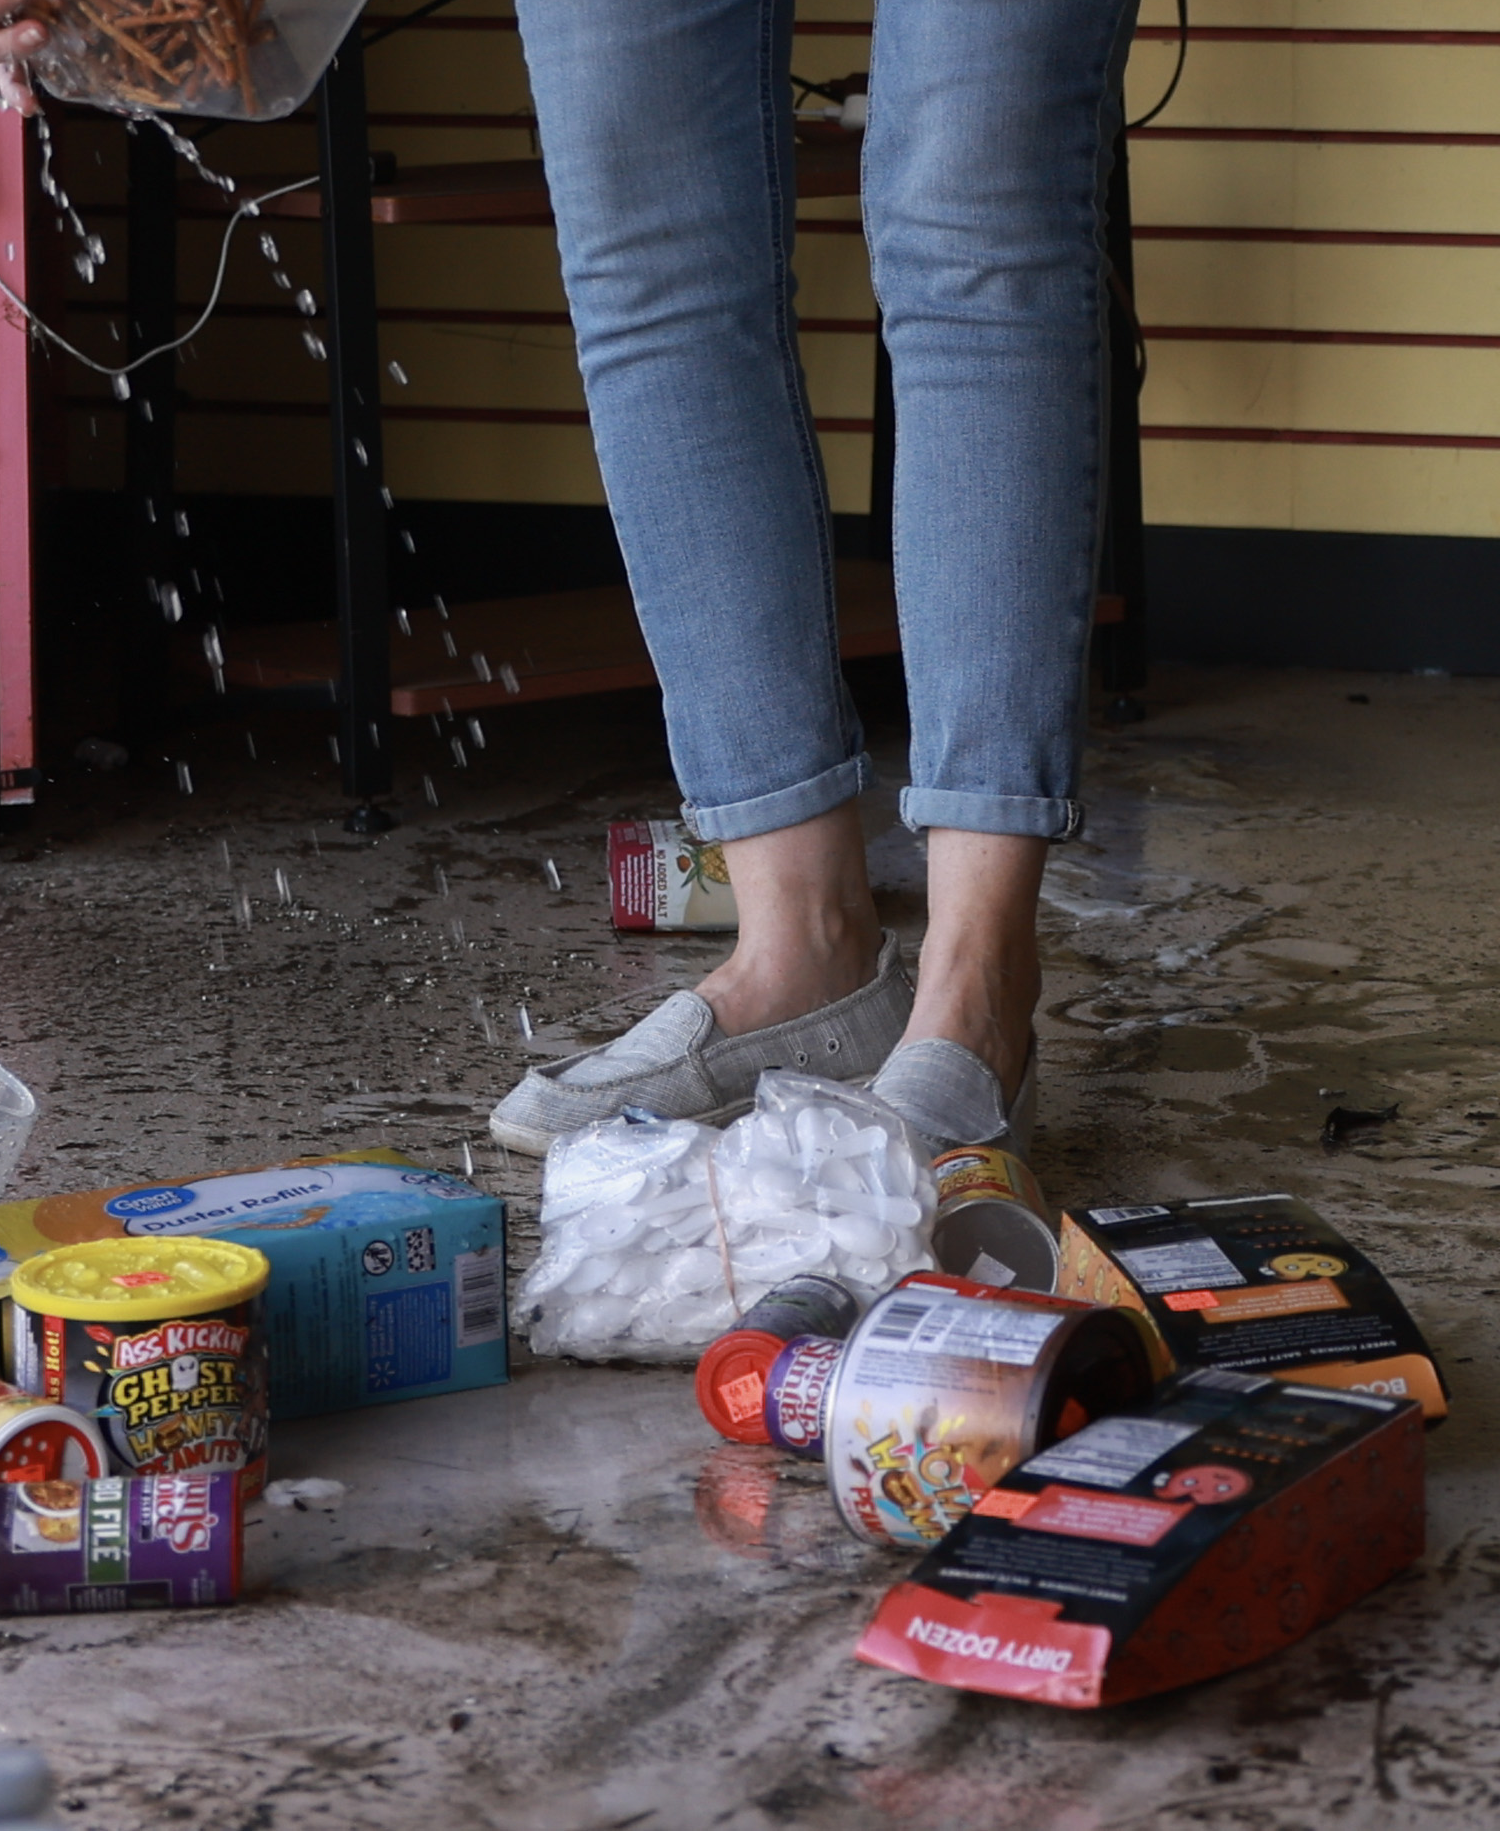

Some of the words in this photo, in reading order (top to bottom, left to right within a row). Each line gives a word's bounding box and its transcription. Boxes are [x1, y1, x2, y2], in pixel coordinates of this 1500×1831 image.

[656, 849, 666, 861] NO
[657, 863, 667, 891] ADDED
[657, 894, 668, 919] SALT
[114, 1190, 177, 1210] Great
[136, 1198, 182, 1213] Value
[141, 1206, 235, 1232] Duster
[238, 1180, 324, 1208] Refills
[119, 1336, 164, 1367] ASS
[128, 1385, 240, 1426] PEPPER
[905, 1615, 1000, 1660] DOZEN
[999, 1637, 1074, 1673] DIRTY
